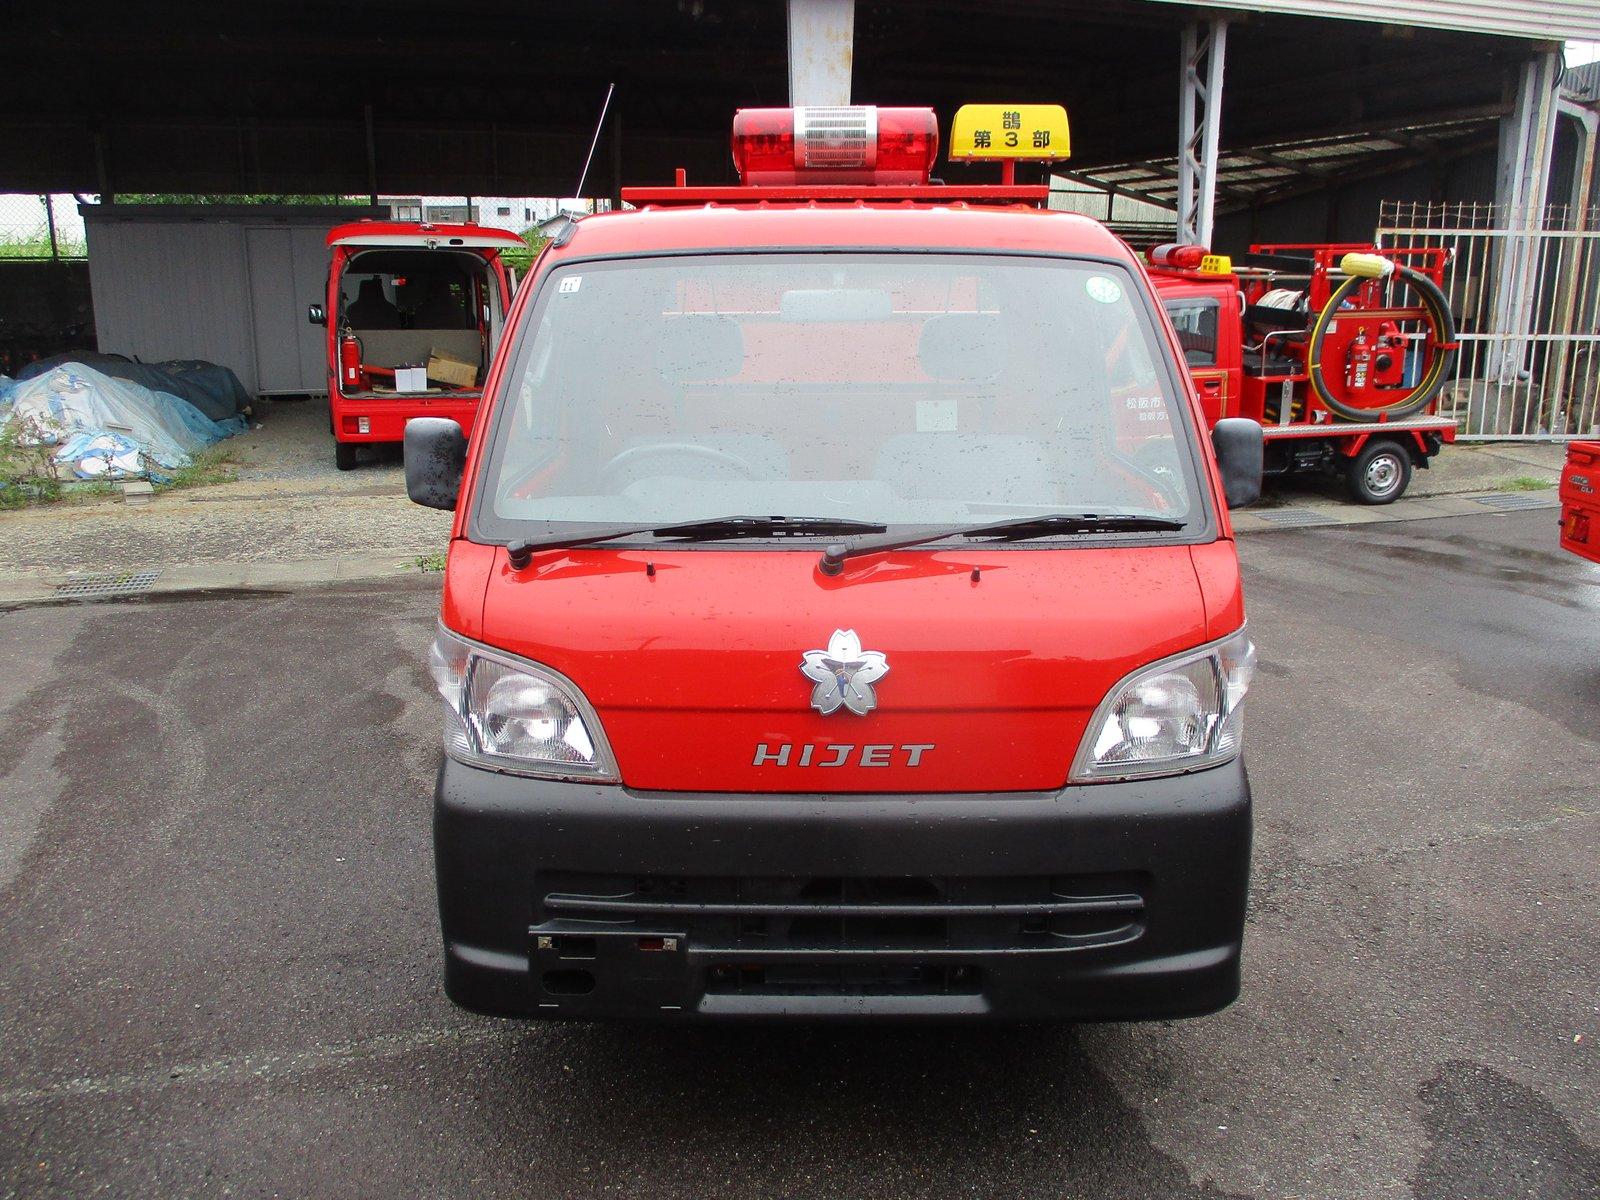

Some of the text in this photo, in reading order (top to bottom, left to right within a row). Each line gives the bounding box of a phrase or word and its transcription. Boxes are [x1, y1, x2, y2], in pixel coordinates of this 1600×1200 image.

[1126, 397, 1166, 410] 松阪市
[752, 743, 936, 767] HIJET
